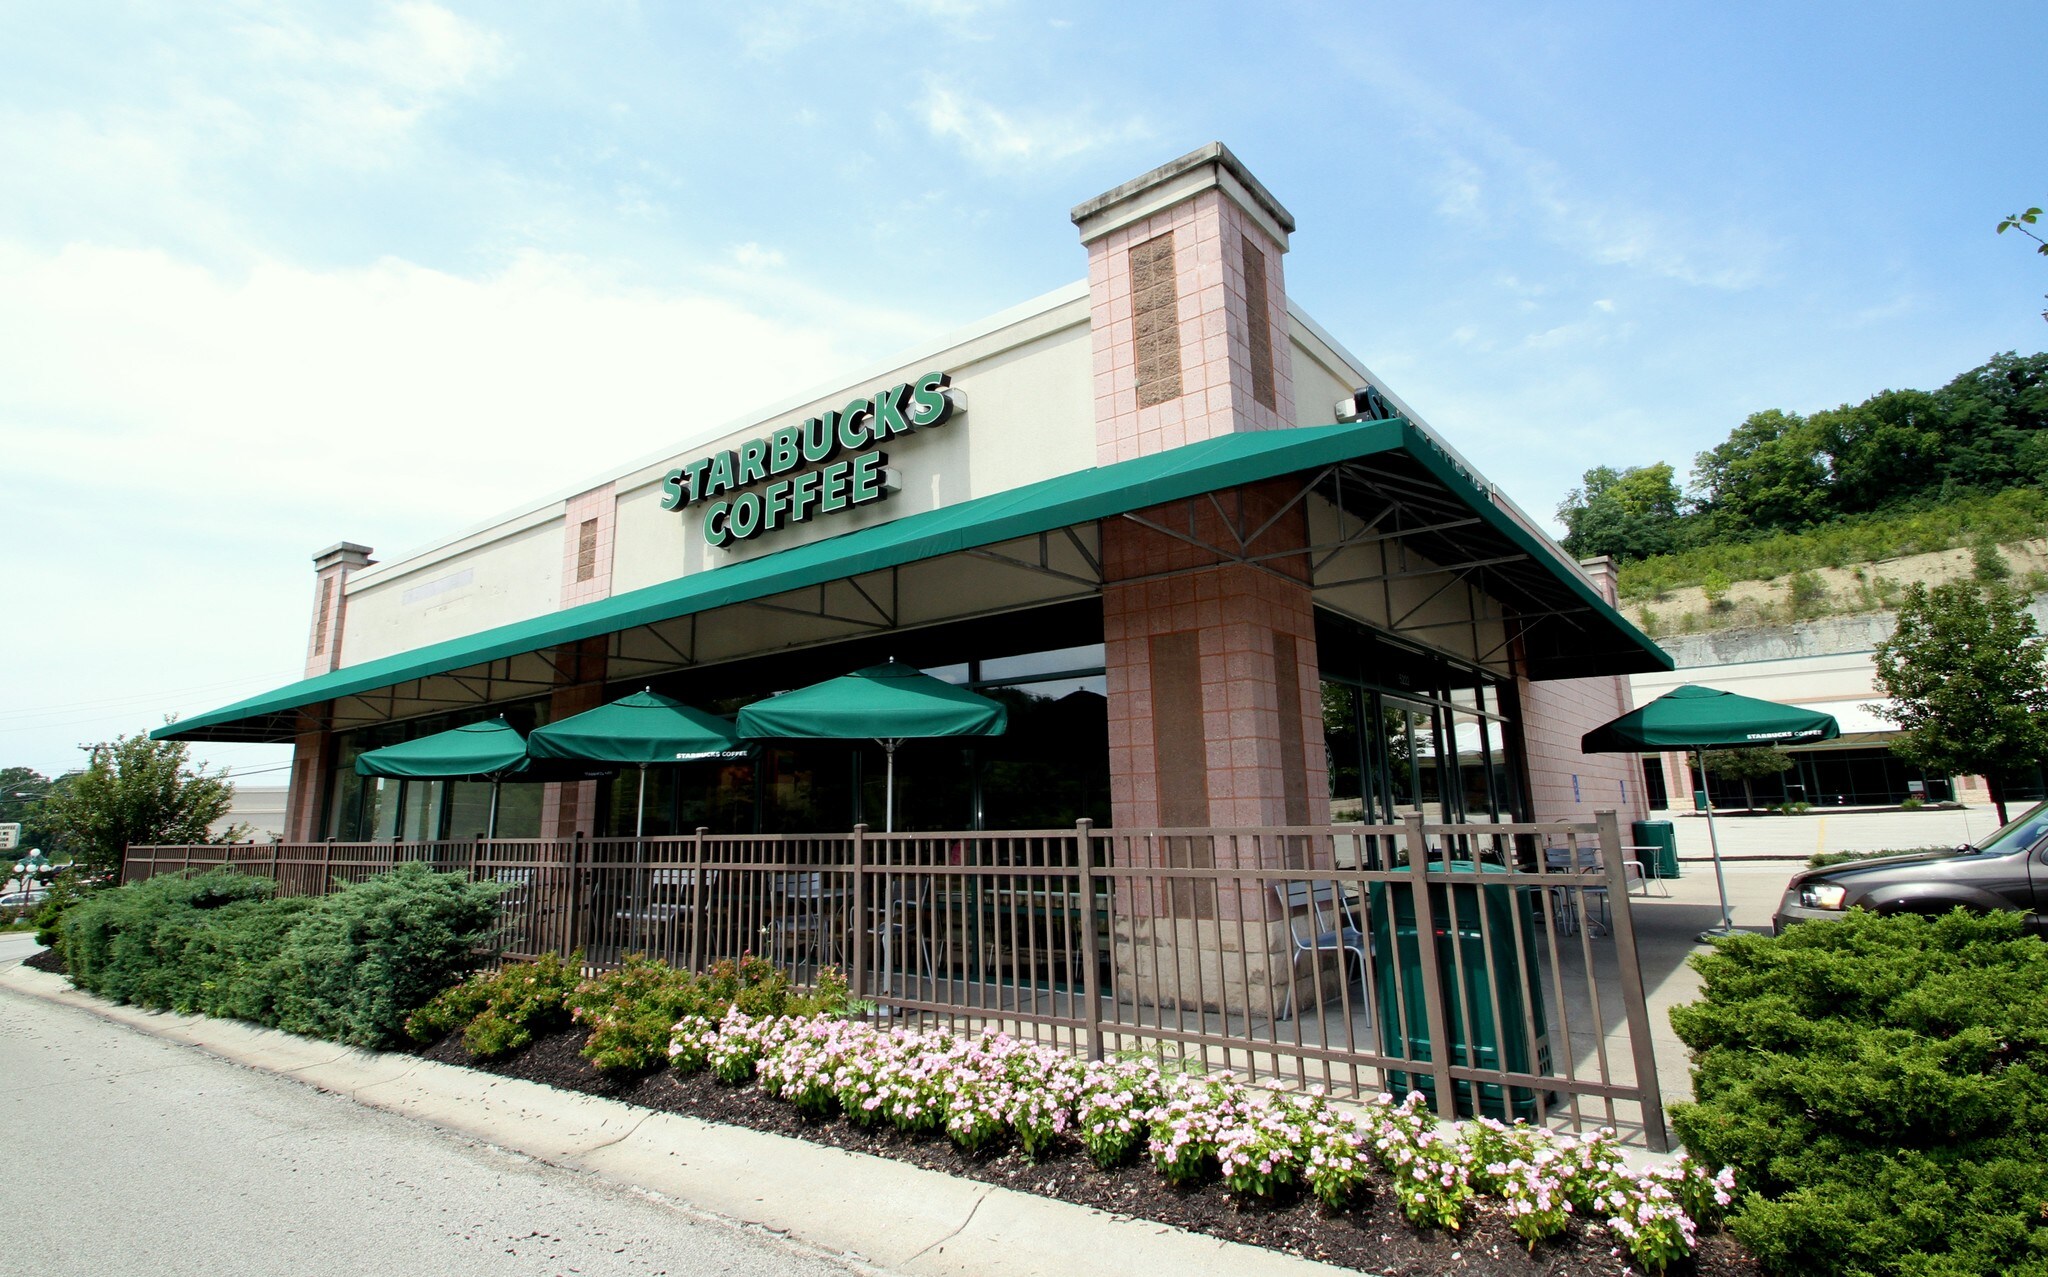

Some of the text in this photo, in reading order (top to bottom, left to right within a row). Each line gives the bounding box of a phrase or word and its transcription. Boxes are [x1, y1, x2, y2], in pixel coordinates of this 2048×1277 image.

[660, 371, 951, 513] STARBUCKS
[702, 450, 886, 547] COFFEE
[676, 751, 721, 759] STARBUCKS
[1746, 731, 1793, 740] STARBUCKS
